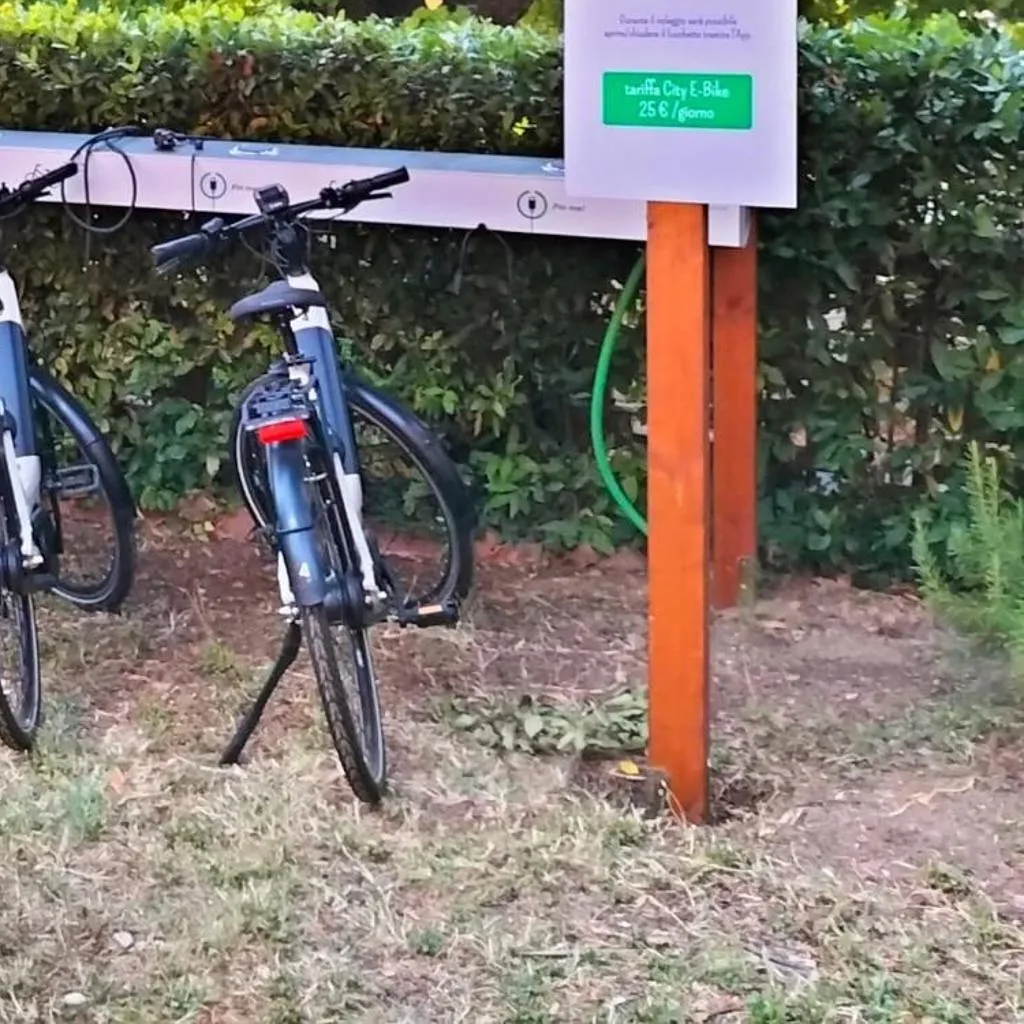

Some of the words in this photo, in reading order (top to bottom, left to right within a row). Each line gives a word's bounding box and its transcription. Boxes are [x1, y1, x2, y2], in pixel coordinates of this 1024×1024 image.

[624, 78, 661, 97] tariffa
[663, 79, 687, 101] City
[690, 80, 730, 98] E-Bike
[639, 100, 656, 118] 25
